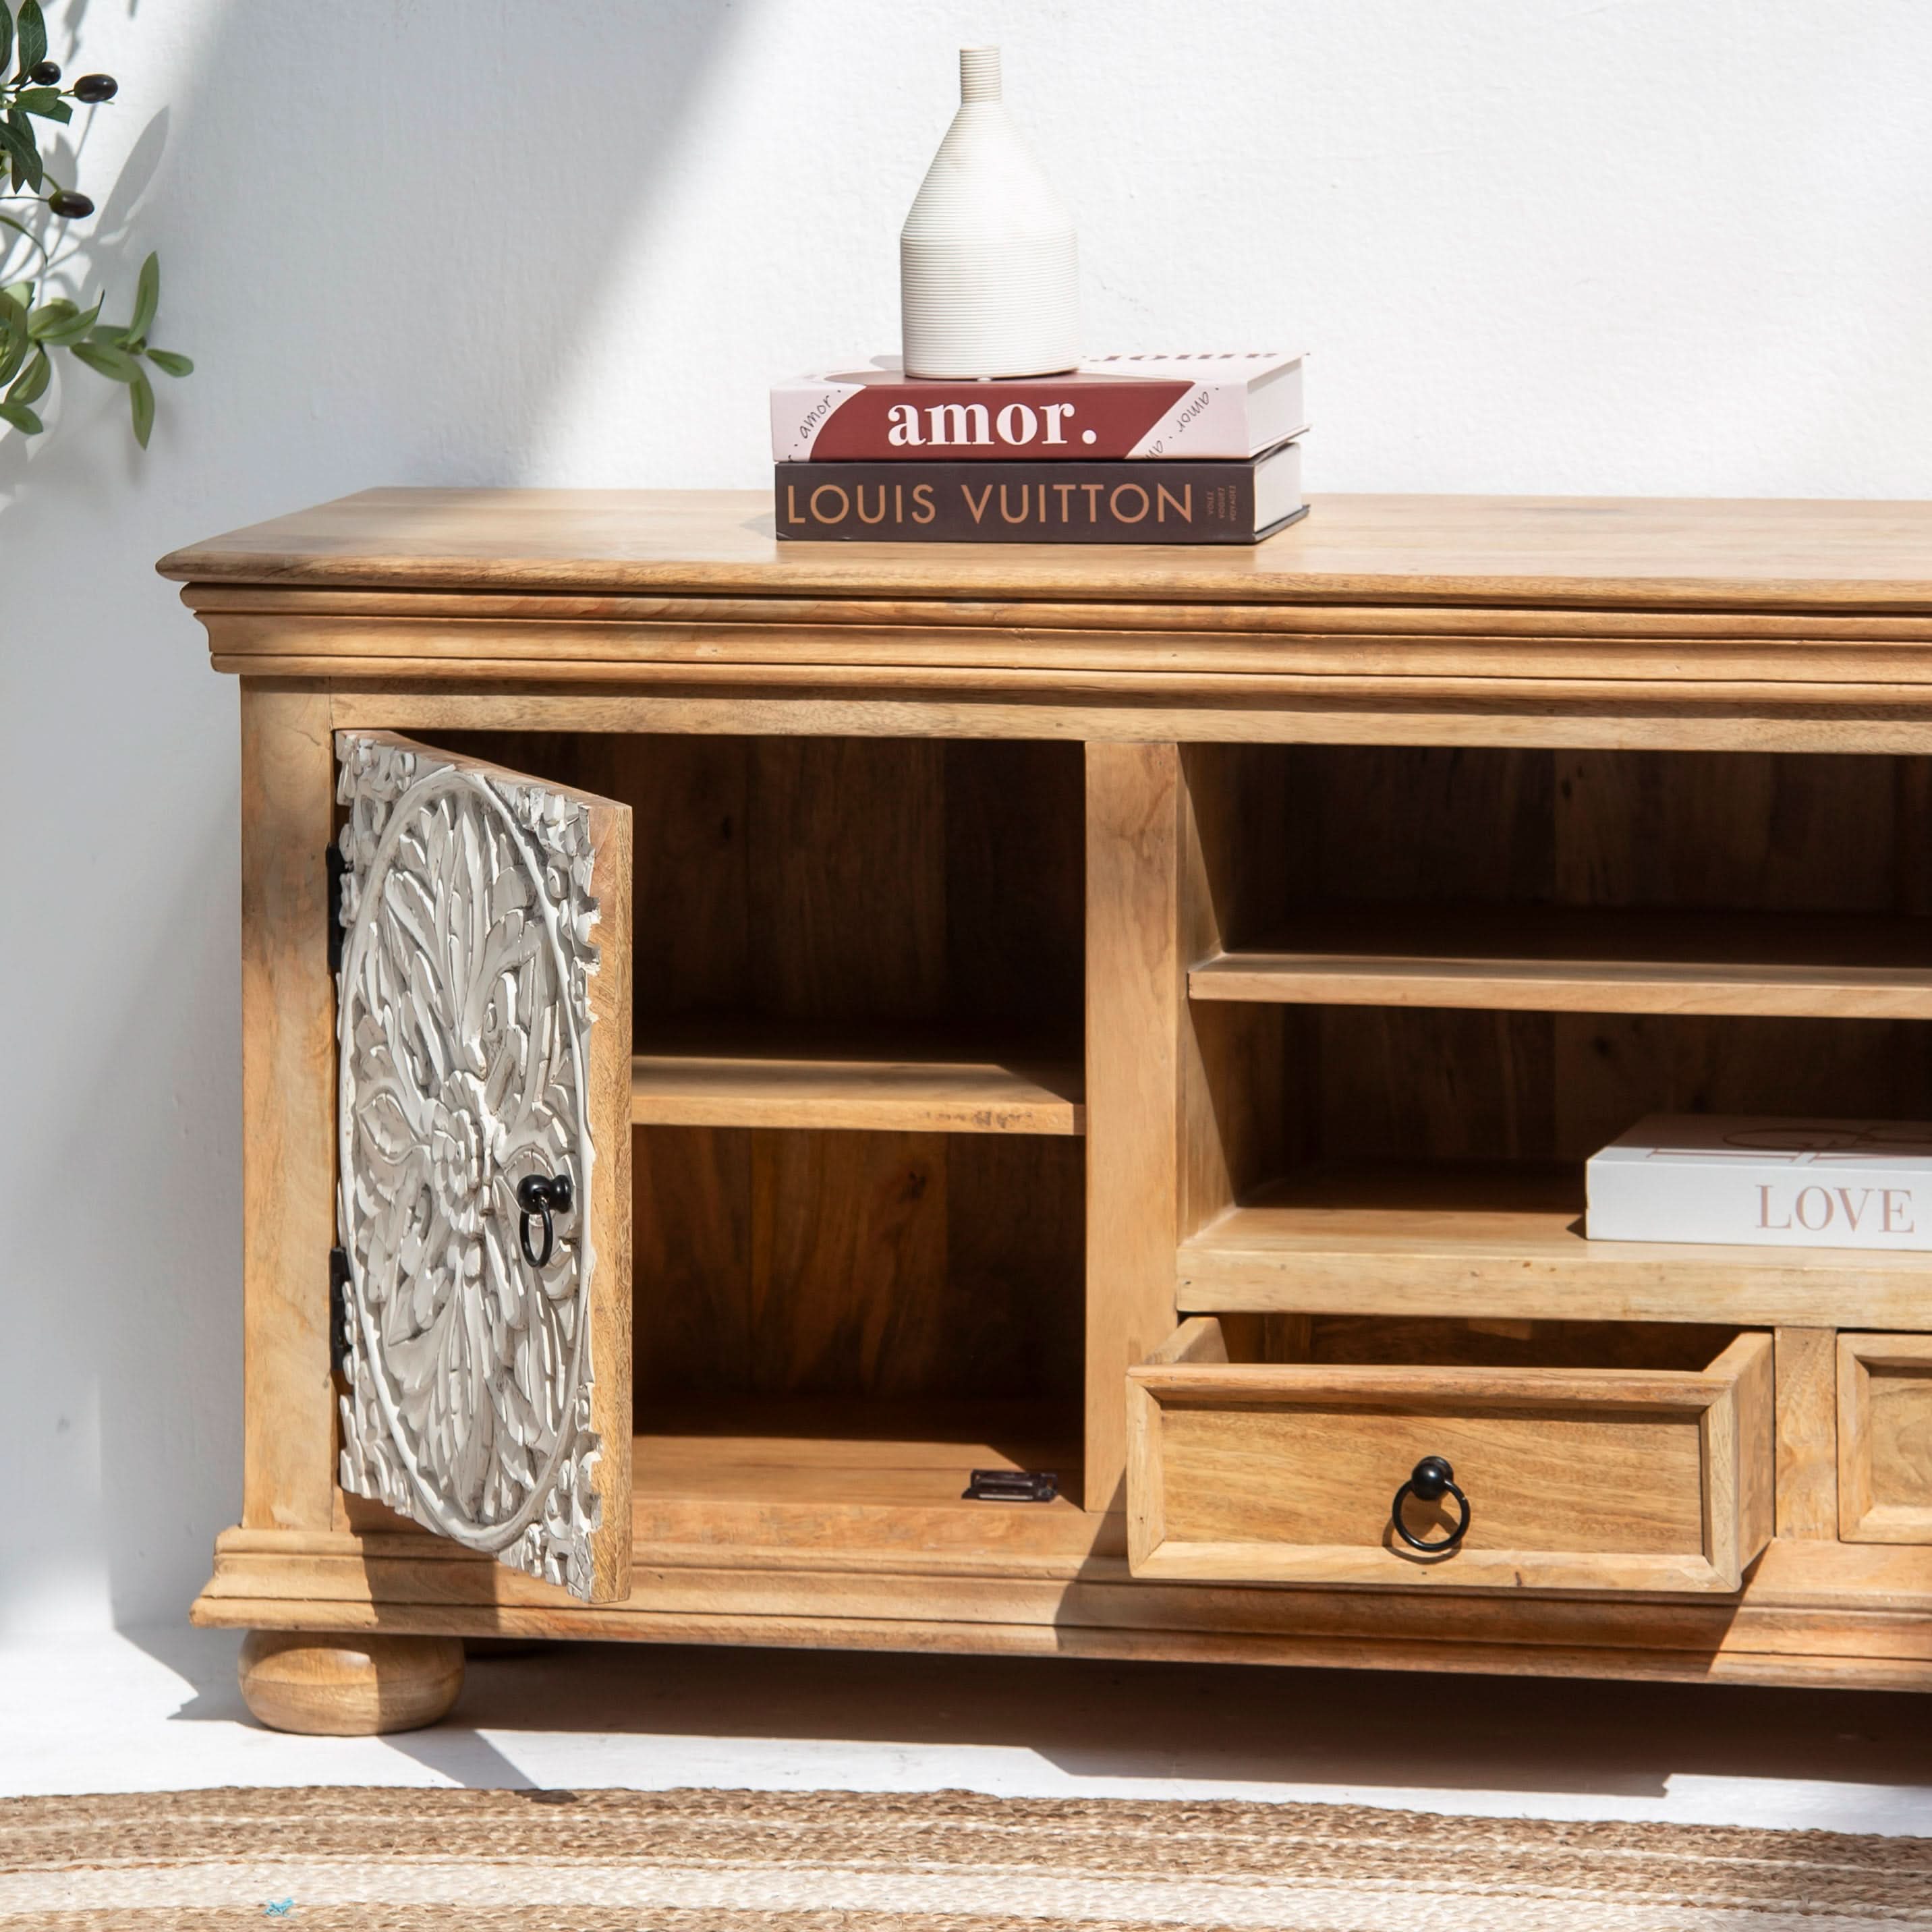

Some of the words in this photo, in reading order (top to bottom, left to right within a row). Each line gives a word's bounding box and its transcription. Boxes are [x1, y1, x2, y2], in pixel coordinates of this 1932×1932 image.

[799, 395, 832, 439] amor
[888, 403, 1097, 446] amor.
[1175, 391, 1210, 432] amor
[787, 484, 936, 524] LOUIS
[960, 483, 1192, 524] VUITTON
[1755, 1185, 1914, 1233] LOVE
